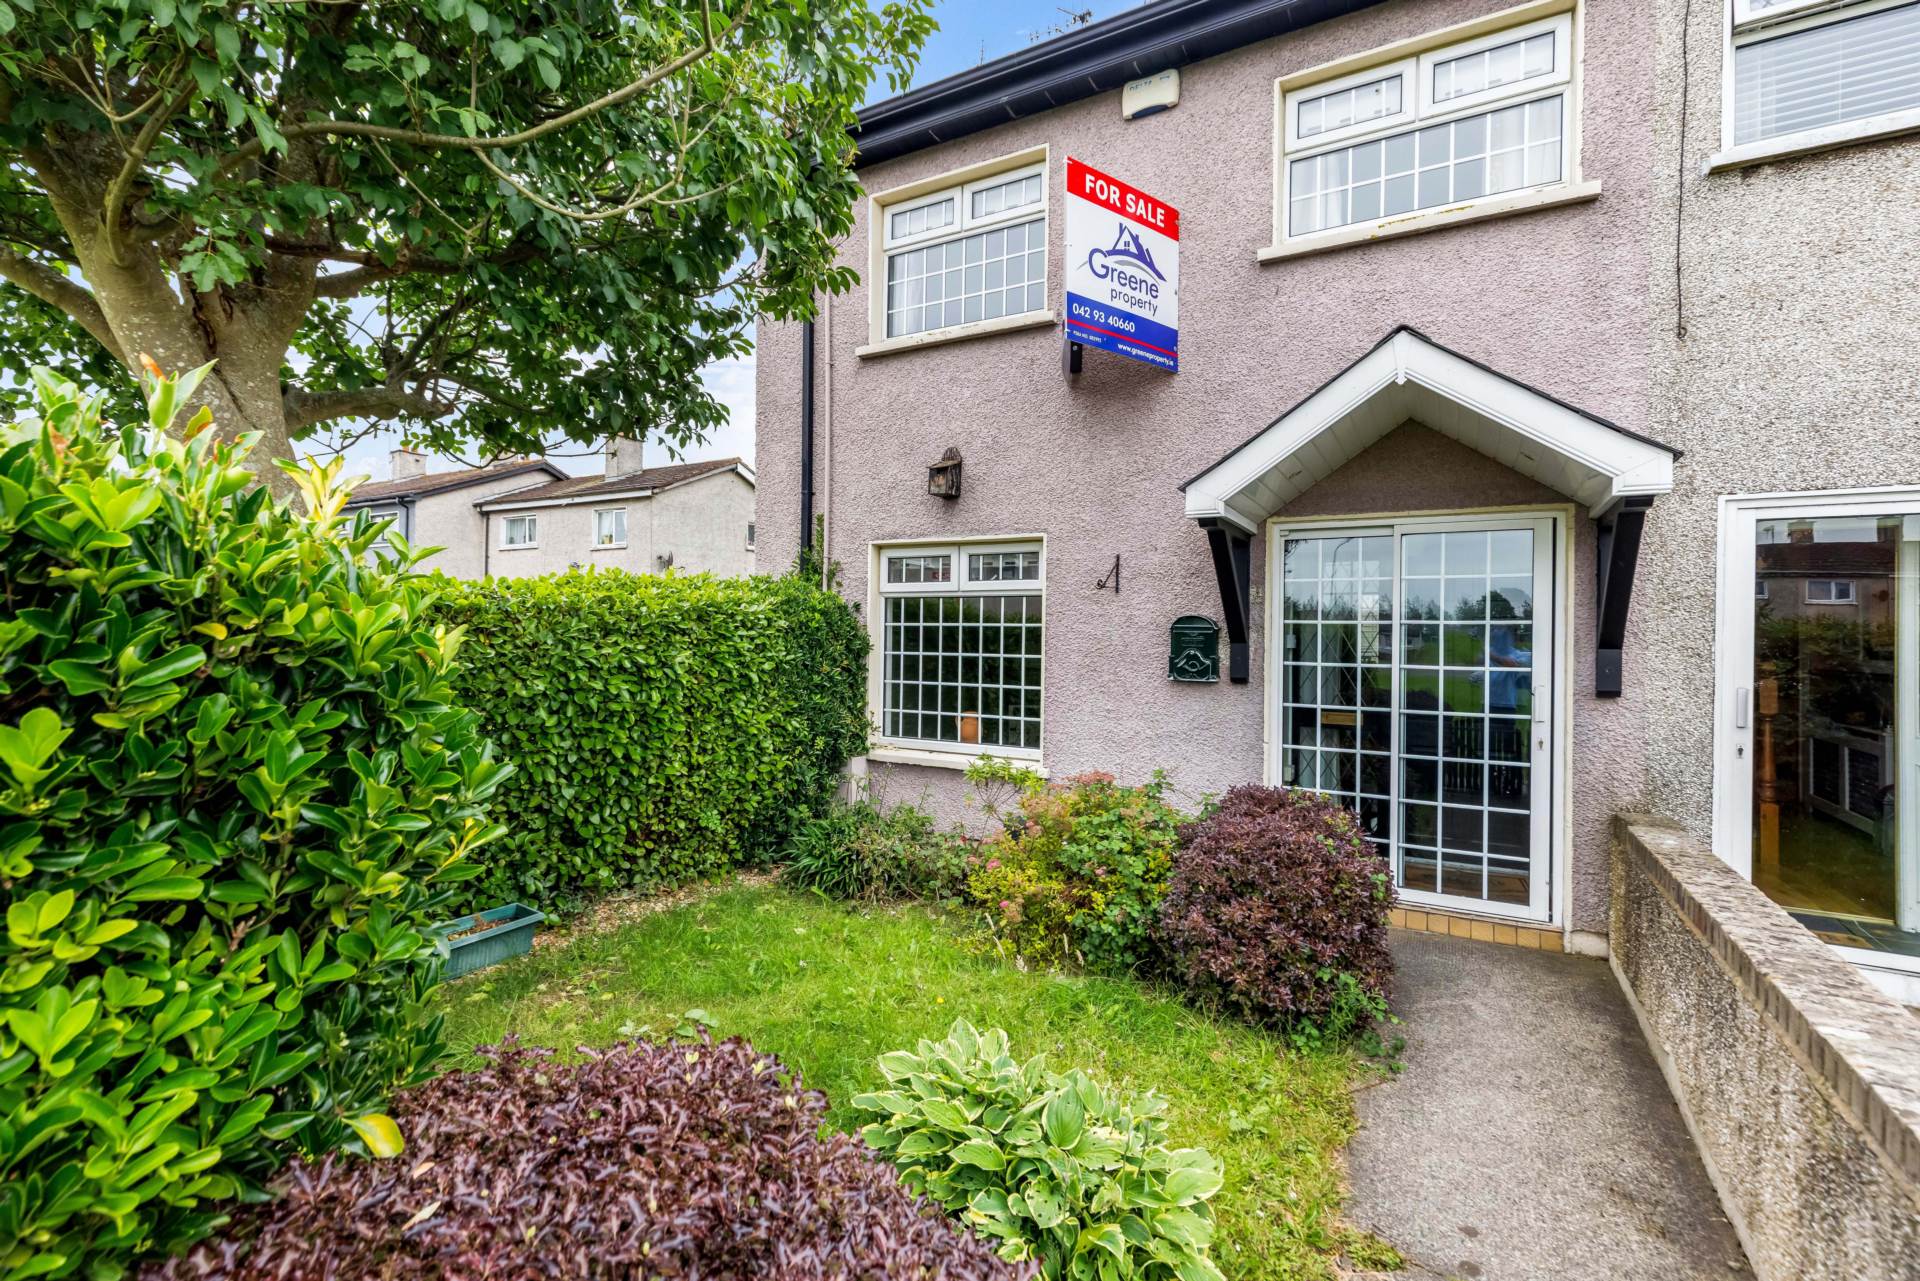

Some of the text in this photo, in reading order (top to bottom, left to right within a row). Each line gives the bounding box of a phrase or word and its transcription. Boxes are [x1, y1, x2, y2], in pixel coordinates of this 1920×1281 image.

[1085, 173, 1165, 227] FOR SALE
[1088, 248, 1159, 299] Greene
[1072, 303, 1135, 333] 042 93 40660
[1110, 286, 1158, 316] property
